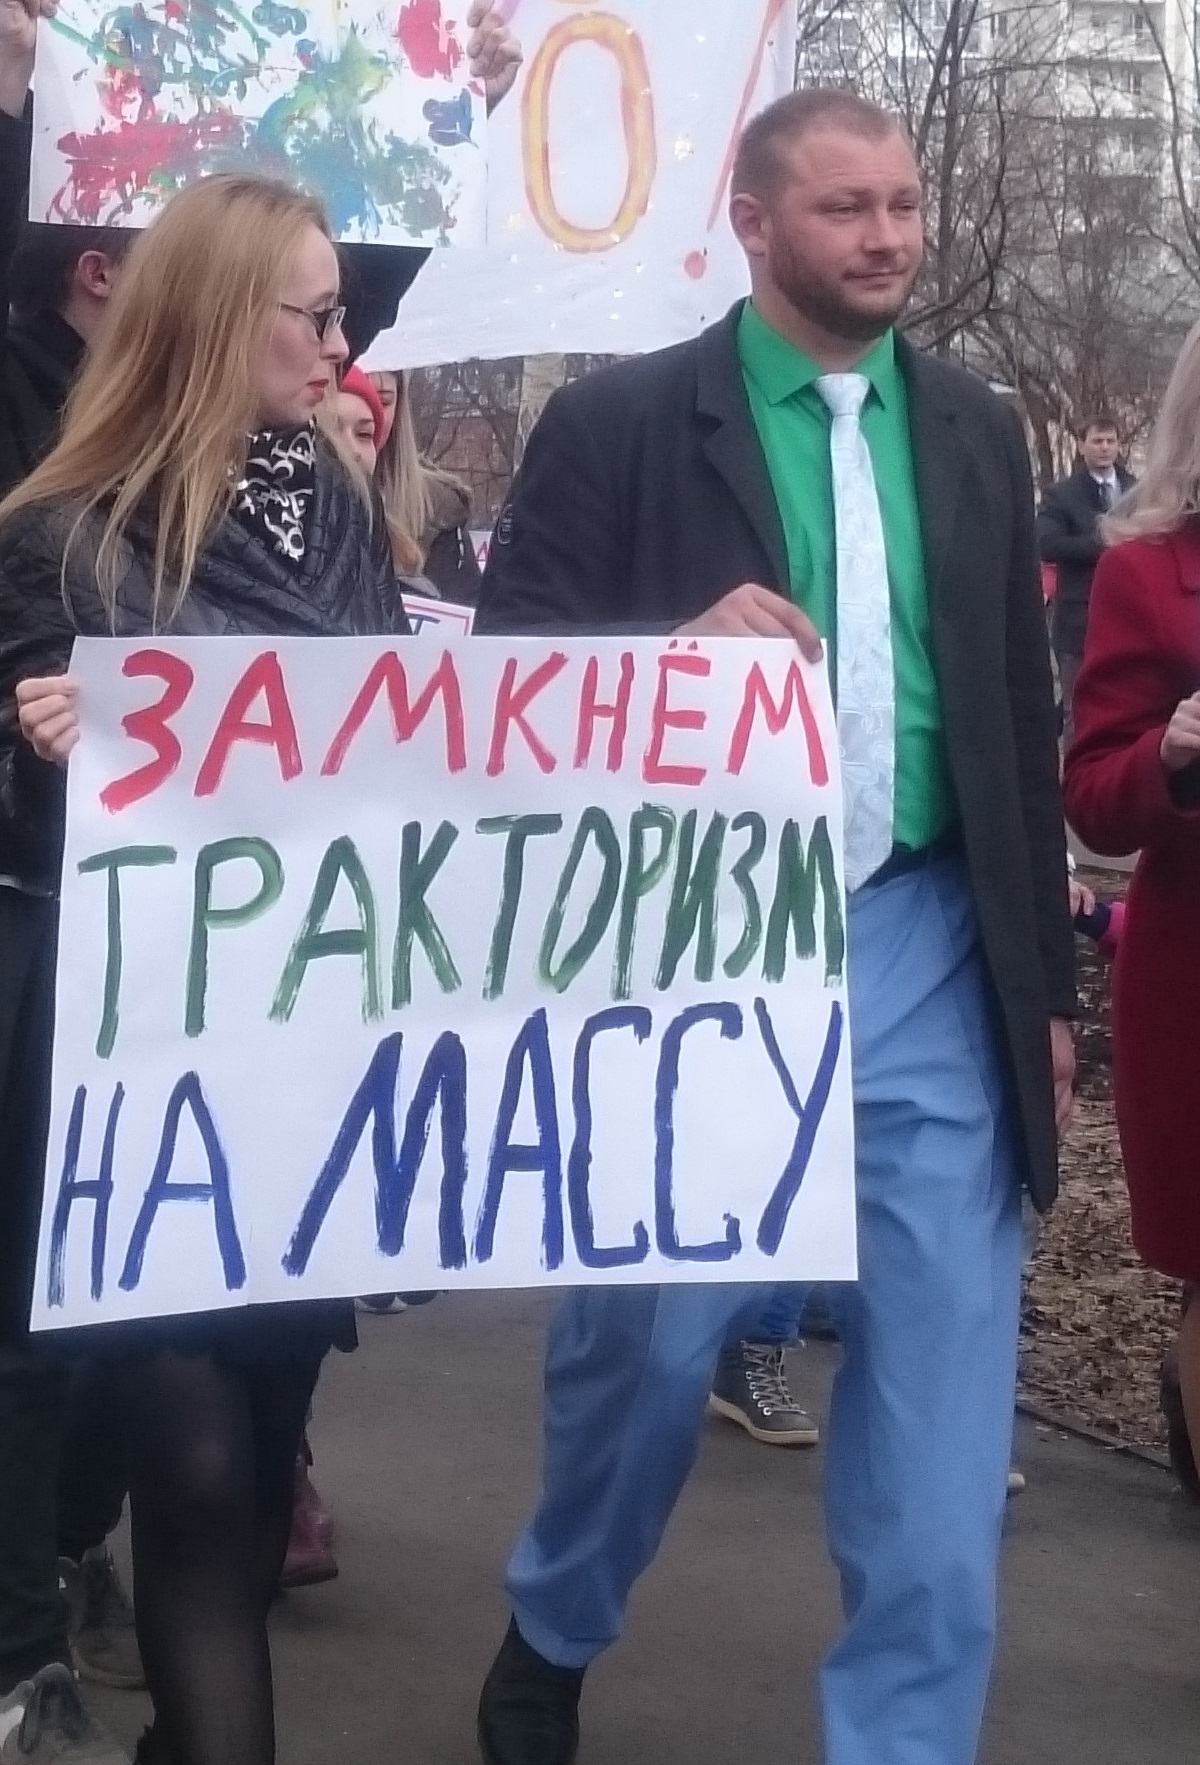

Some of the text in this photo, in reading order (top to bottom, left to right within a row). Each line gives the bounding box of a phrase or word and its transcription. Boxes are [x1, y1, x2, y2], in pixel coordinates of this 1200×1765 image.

[99, 639, 831, 812] ЗАМКНЁМ
[77, 802, 844, 1059] ТРАКТОРИЗМ
[46, 997, 844, 1308] НА МАССУ
